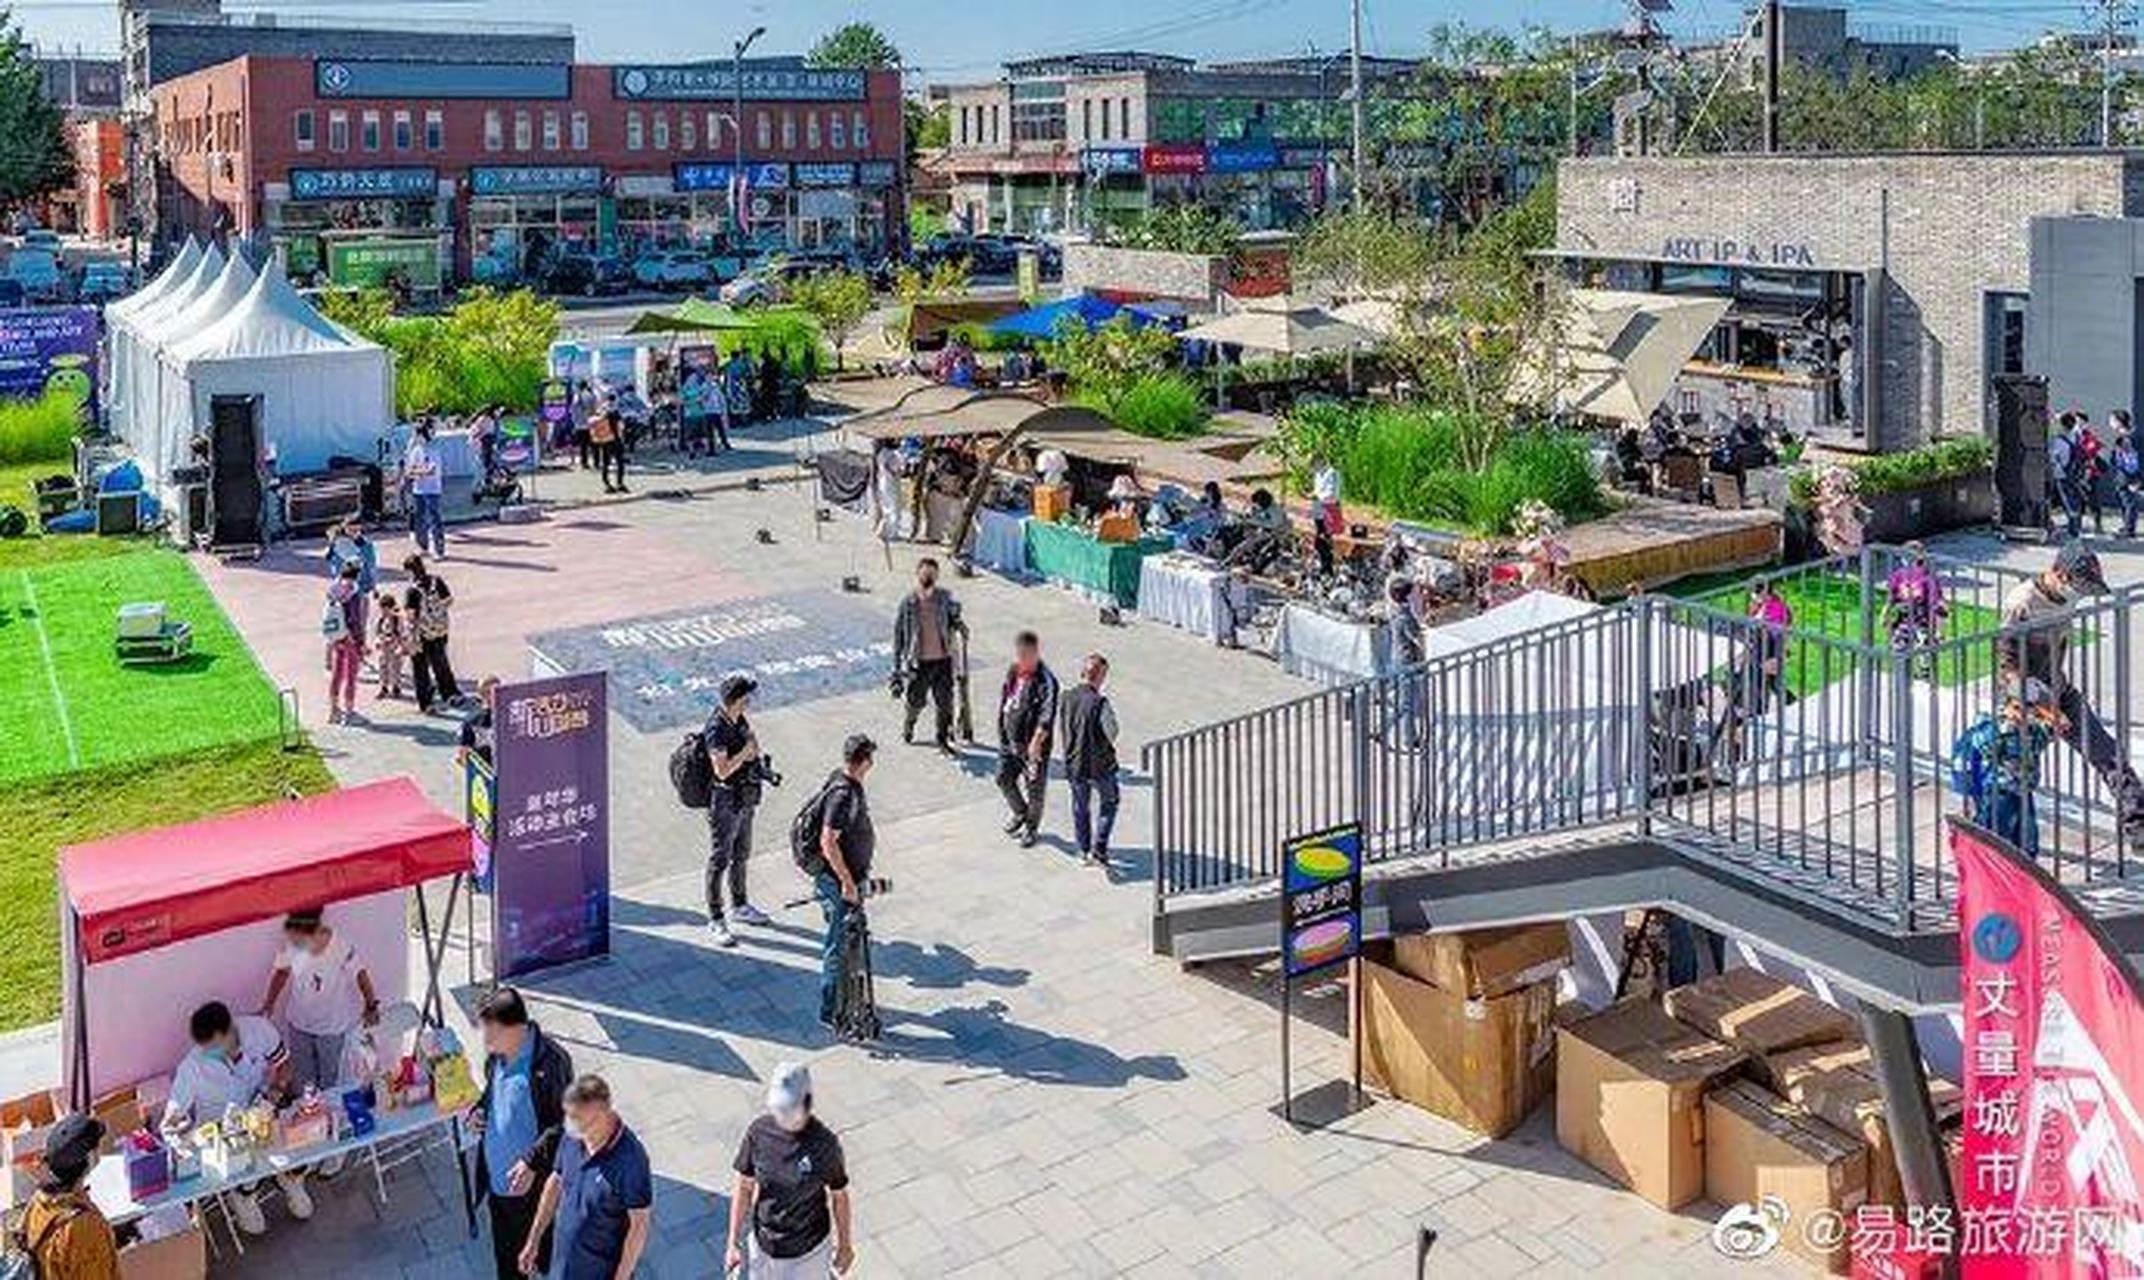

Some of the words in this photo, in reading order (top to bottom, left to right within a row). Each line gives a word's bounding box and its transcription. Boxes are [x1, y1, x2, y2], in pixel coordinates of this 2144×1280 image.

[1662, 238, 1702, 259] ART
[1773, 244, 1814, 266] IPA
[1974, 971, 2019, 1196] 丈量城市
